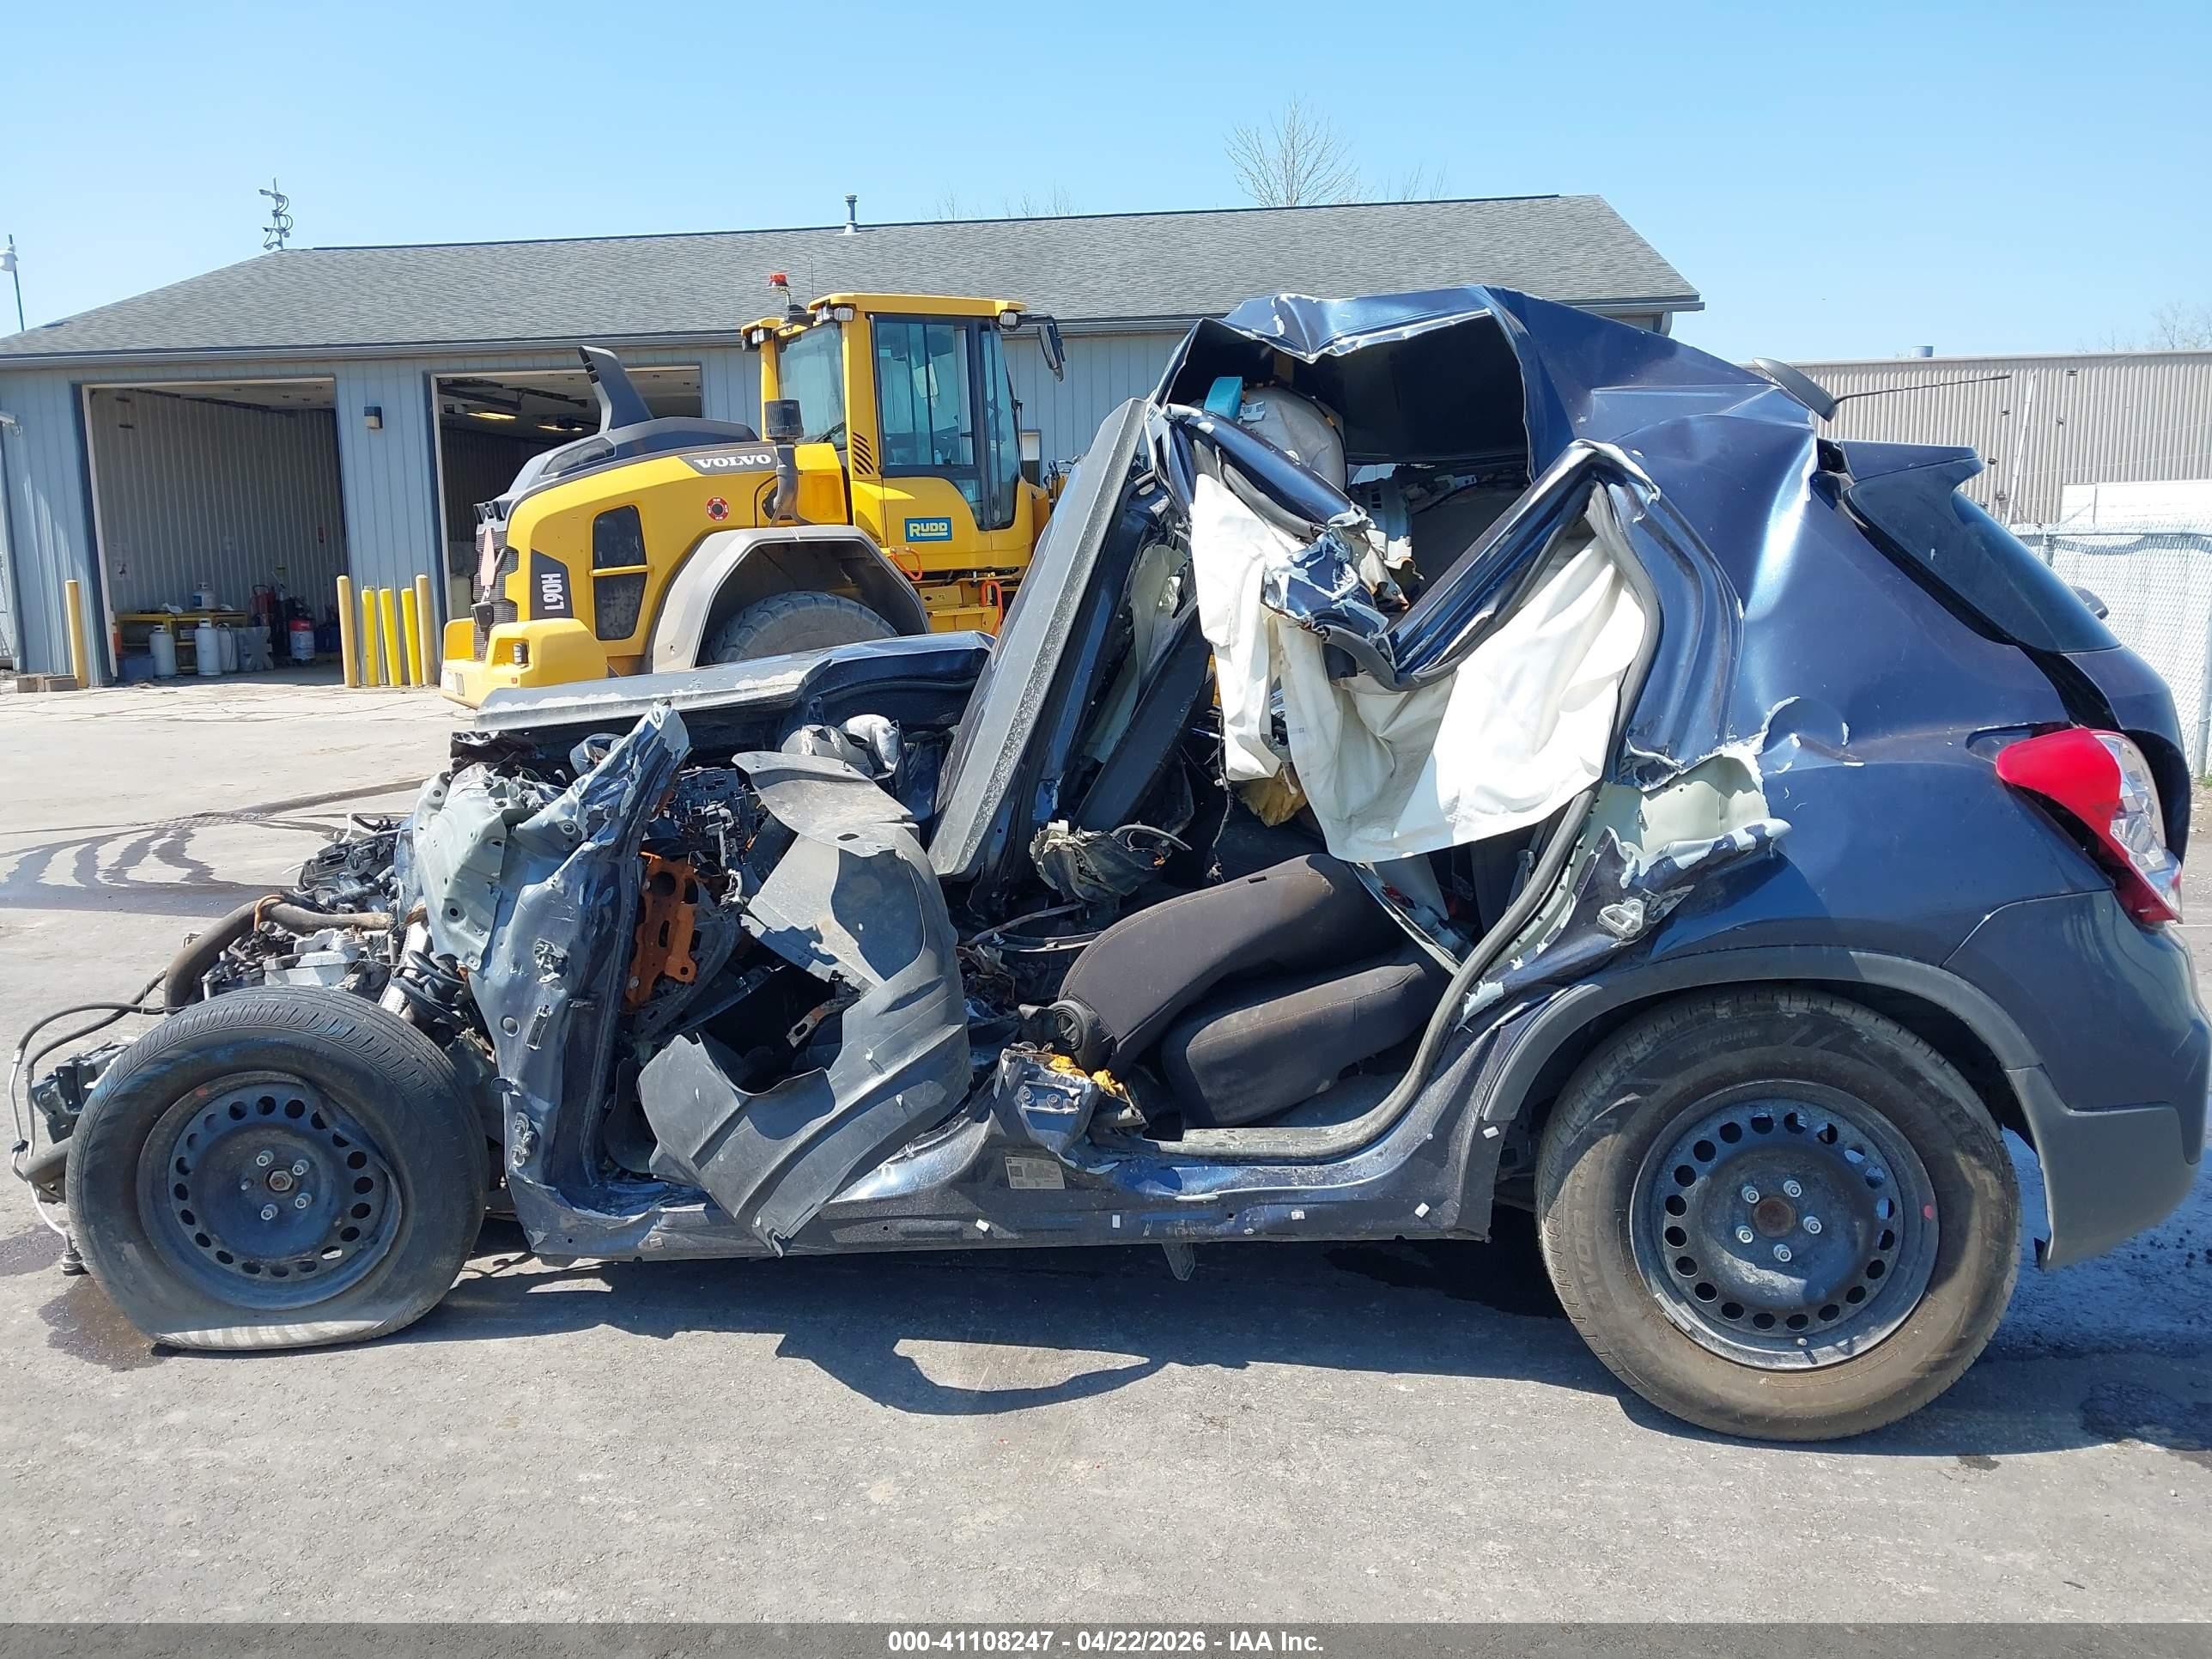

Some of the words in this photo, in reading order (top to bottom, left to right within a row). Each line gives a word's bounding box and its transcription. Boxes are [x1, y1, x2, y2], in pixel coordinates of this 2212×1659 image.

[694, 454, 771, 469] VOLVO
[908, 522, 948, 537] RUDD
[540, 573, 565, 611] L90H
